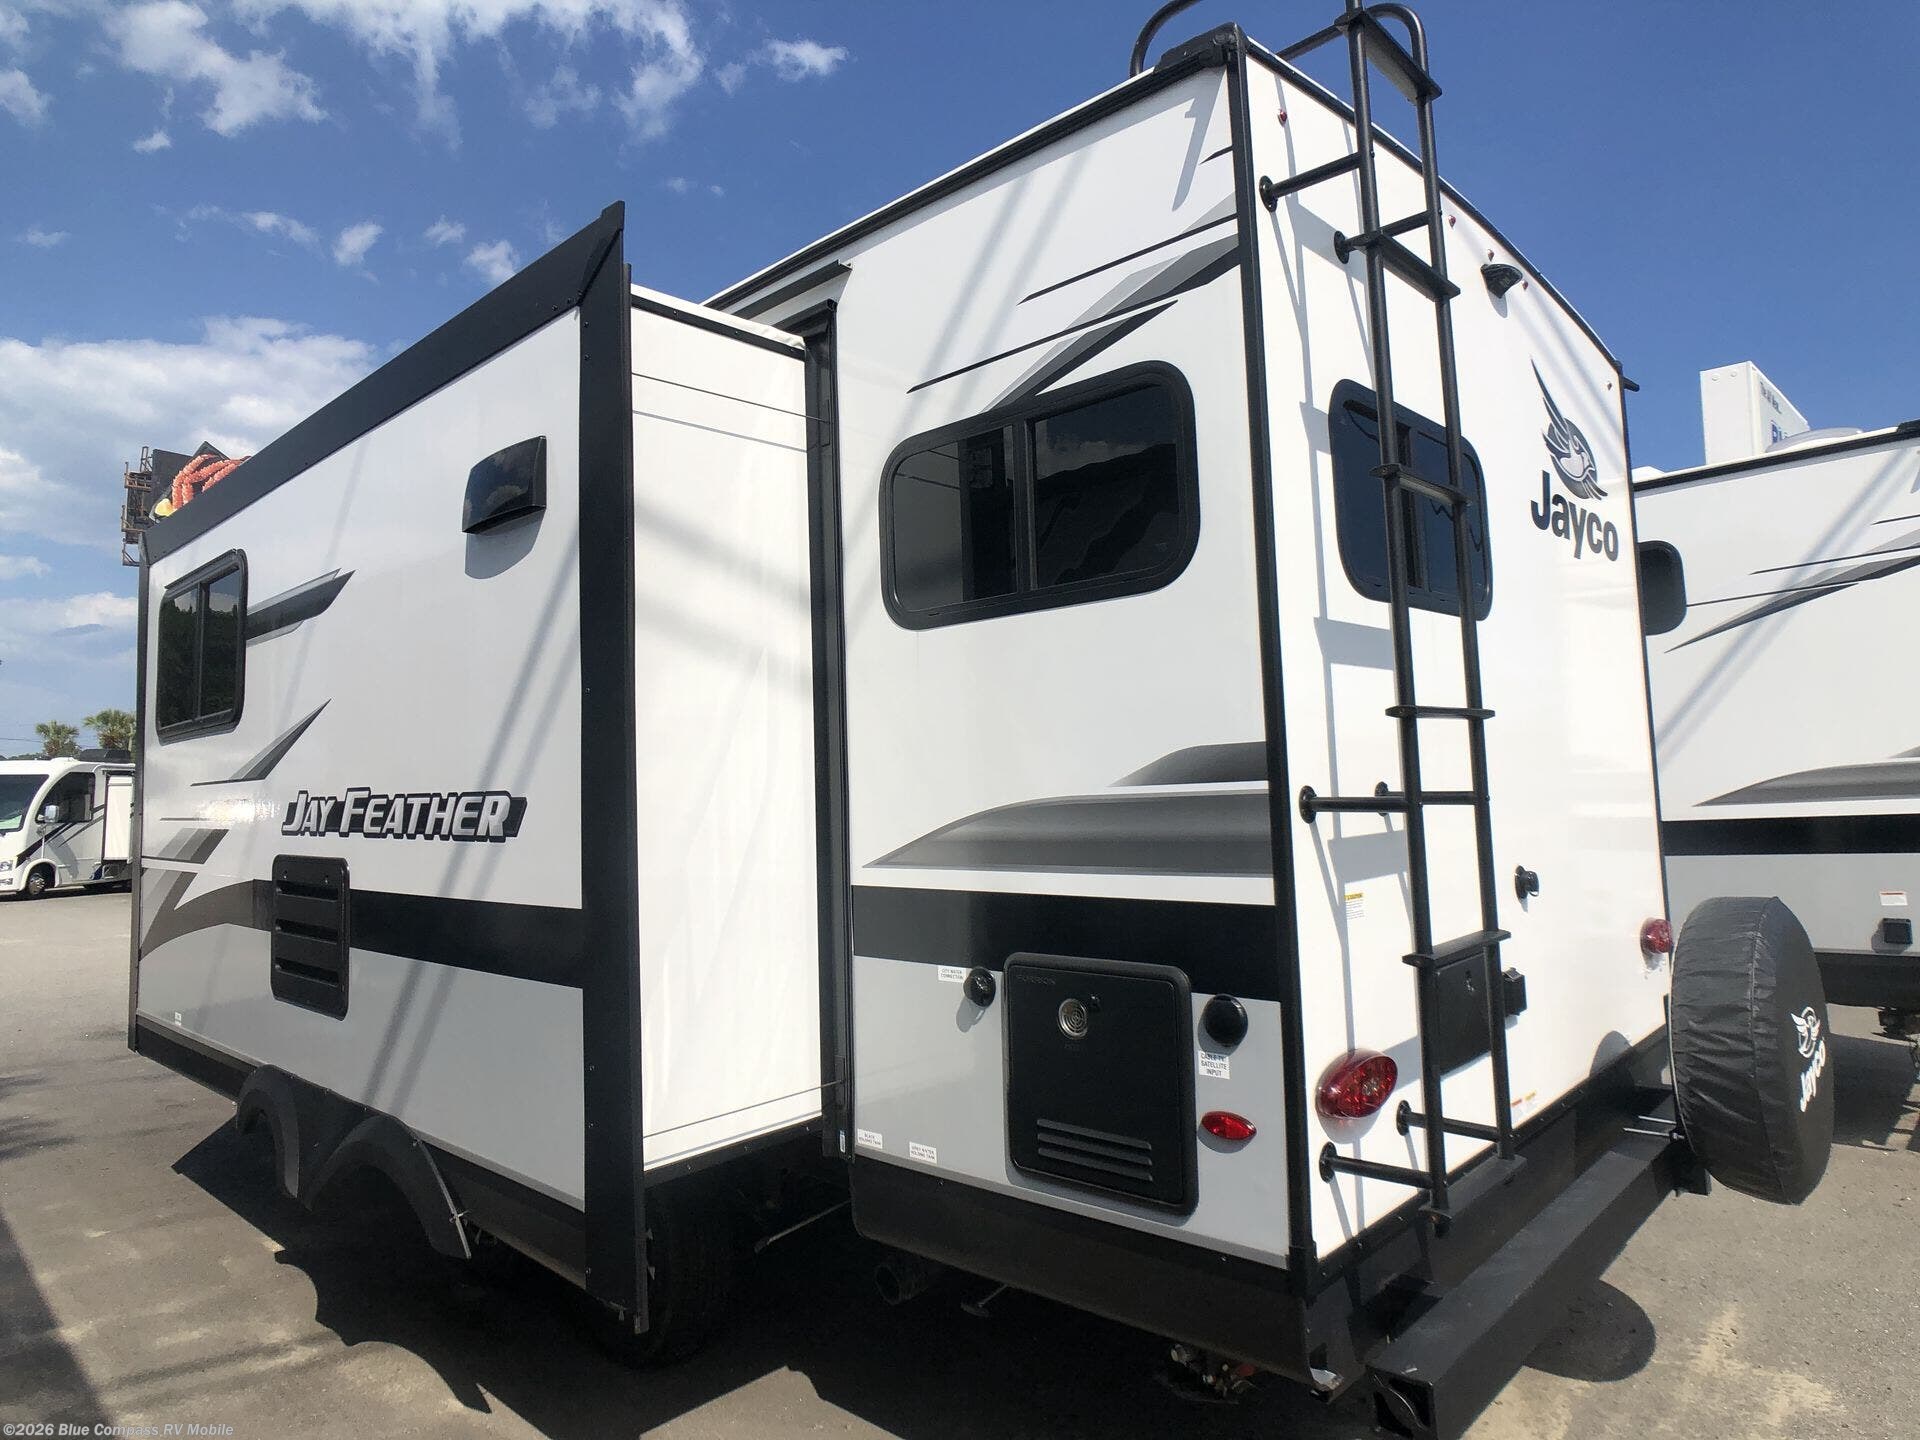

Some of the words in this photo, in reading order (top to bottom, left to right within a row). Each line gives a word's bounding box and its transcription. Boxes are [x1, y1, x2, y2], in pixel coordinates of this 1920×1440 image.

[1530, 469, 1619, 562] Jayco
[281, 790, 338, 838] JAY
[339, 786, 514, 843] FEATHER
[1200, 1060, 1227, 1071] SATELLITE
[1206, 1069, 1222, 1077] INPUT
[1799, 1039, 1827, 1113] Jayco
